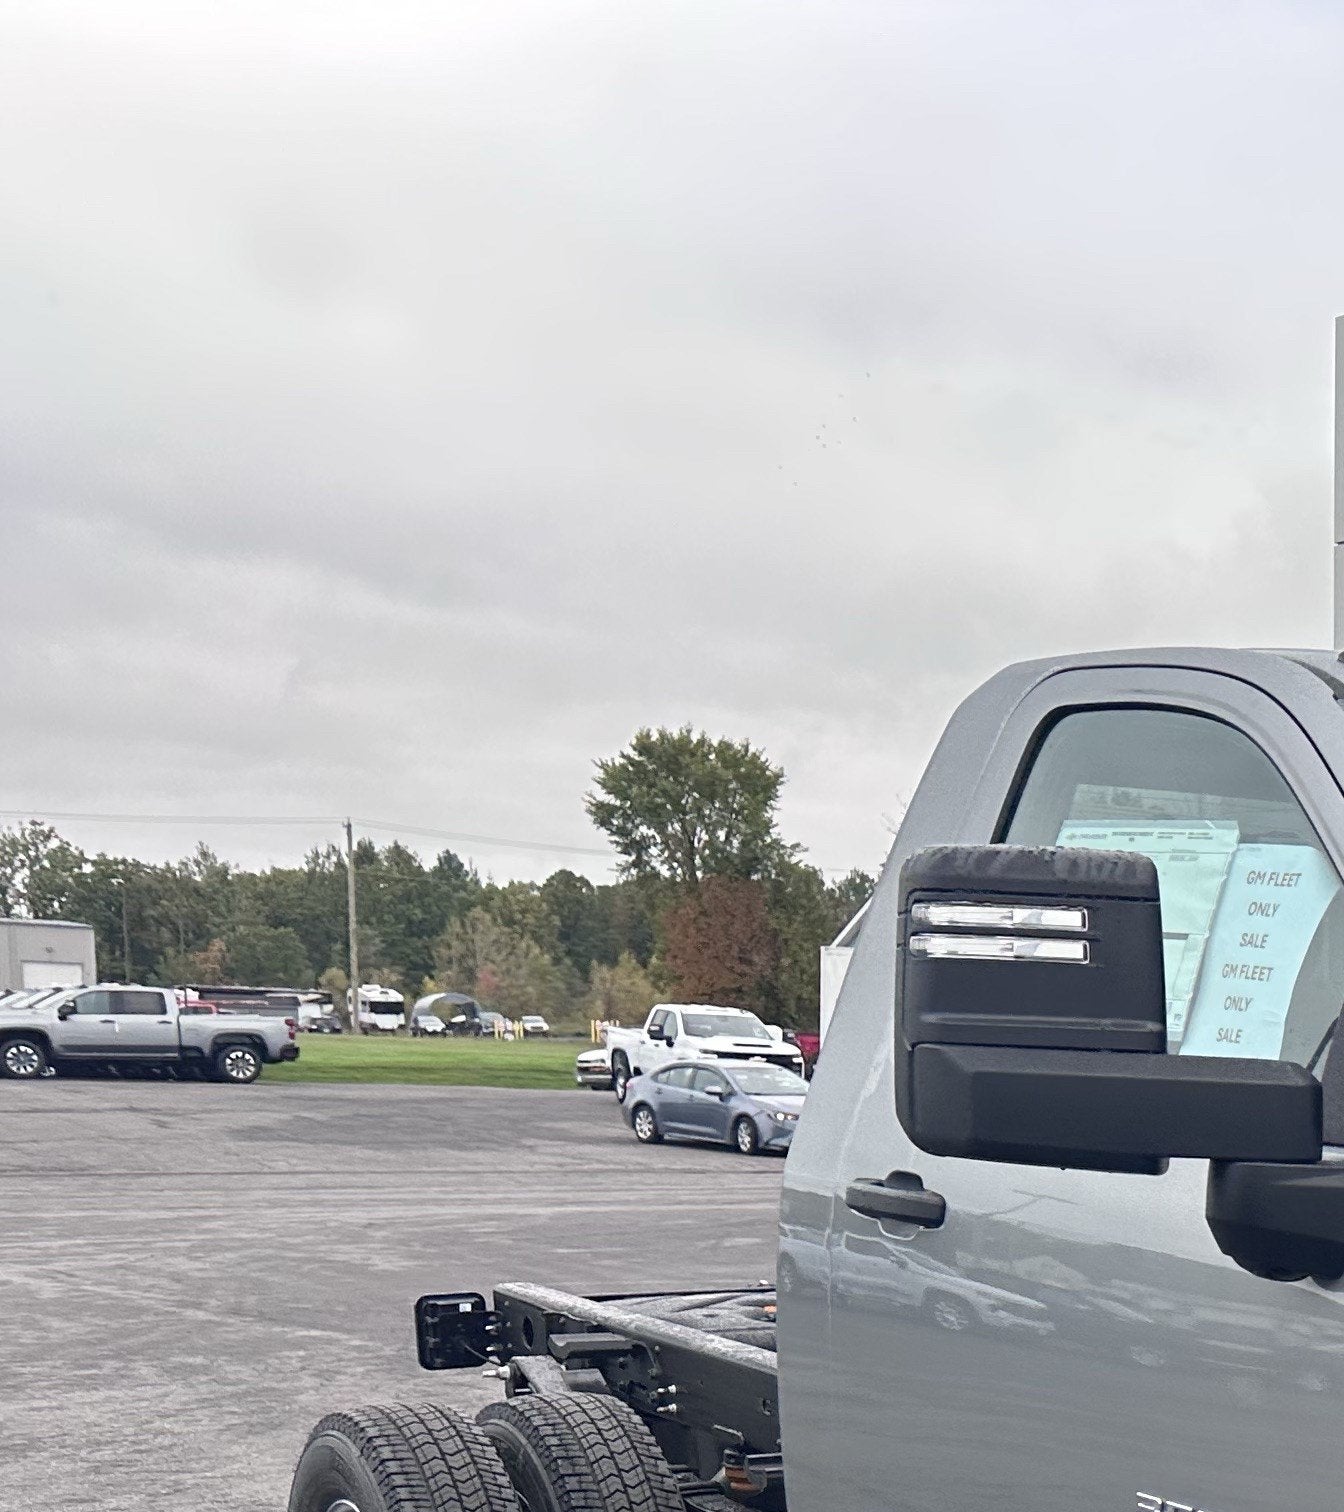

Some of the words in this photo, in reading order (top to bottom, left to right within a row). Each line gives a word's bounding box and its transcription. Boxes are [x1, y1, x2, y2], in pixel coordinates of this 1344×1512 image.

[1246, 870, 1267, 886] GM
[1267, 871, 1303, 888] FLEET
[1247, 901, 1281, 918] ONLY
[1240, 932, 1269, 949] SALE
[1221, 963, 1239, 979] GM
[1239, 963, 1275, 982] FLEET
[1223, 995, 1255, 1012] ONLY
[1216, 1027, 1243, 1044] SALE
